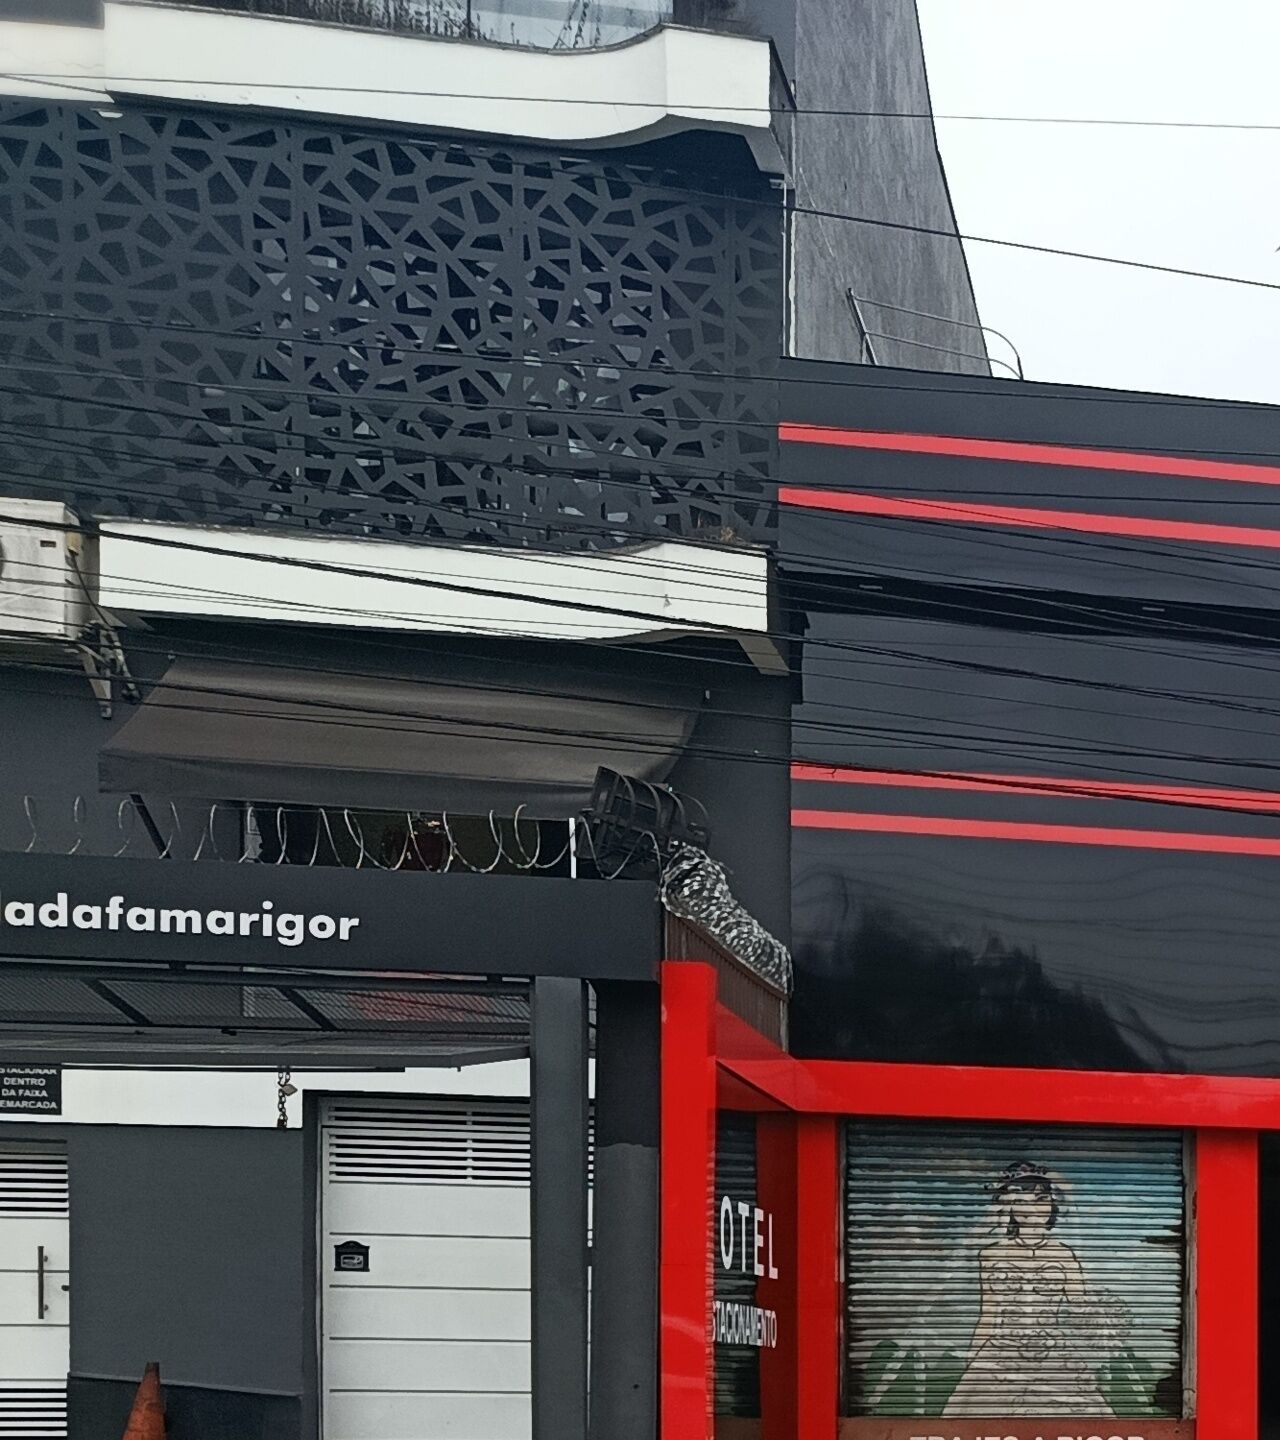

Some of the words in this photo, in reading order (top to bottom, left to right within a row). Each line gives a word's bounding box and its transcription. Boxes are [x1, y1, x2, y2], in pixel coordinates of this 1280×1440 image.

[0, 892, 360, 946] adafamarigor
[2, 1088, 16, 1096] DA
[18, 1089, 48, 1097] FAIXA
[3, 1077, 46, 1086] DENTRO
[720, 1195, 778, 1280] OTEL
